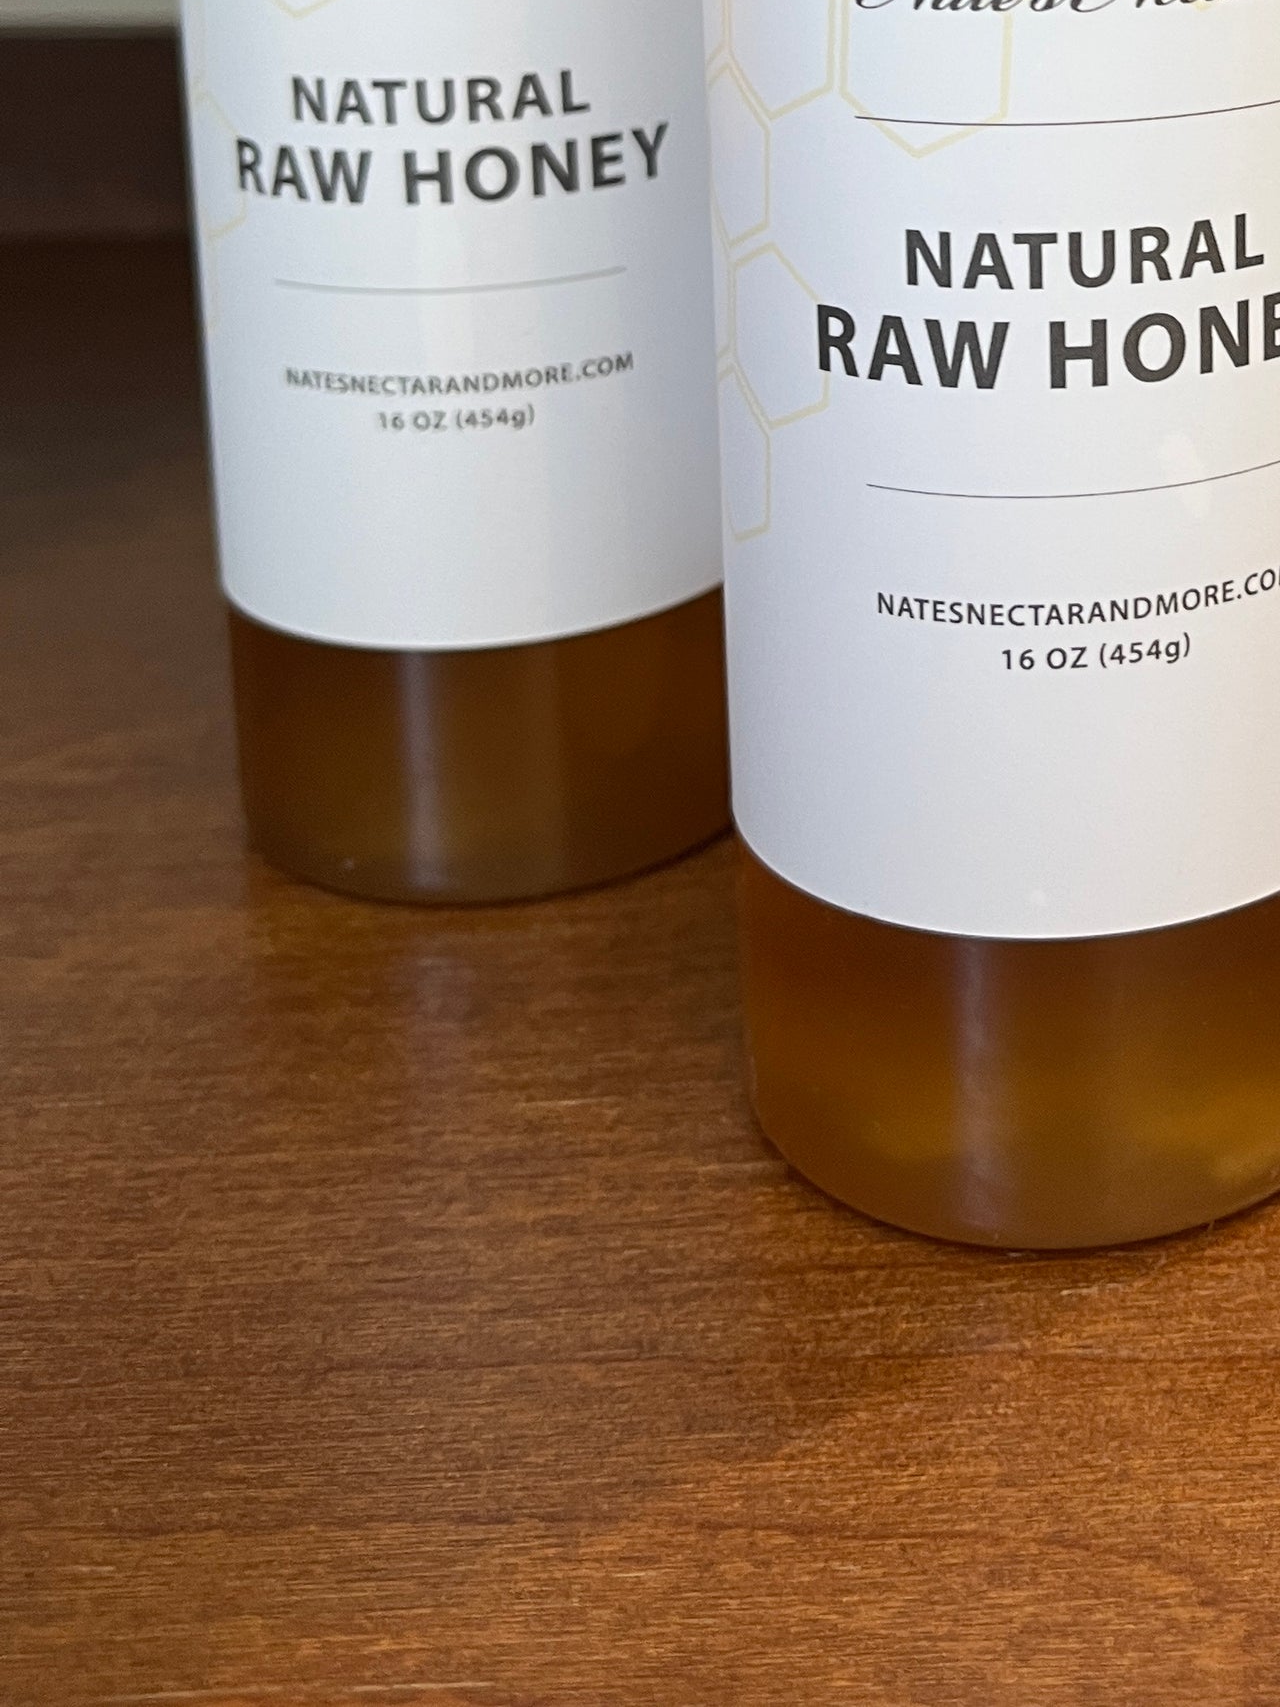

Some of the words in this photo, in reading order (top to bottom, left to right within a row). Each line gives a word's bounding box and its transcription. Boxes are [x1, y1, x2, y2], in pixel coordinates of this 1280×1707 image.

[292, 70, 590, 125] NATURAL
[236, 138, 372, 204] RAW
[403, 120, 667, 205] HONEY
[906, 213, 1264, 290] NATURAL
[817, 304, 1010, 389] RAW
[379, 412, 405, 430] 16
[414, 410, 447, 432] OZ
[454, 404, 534, 430] (454g)
[1002, 649, 1035, 670] 16
[1046, 647, 1088, 669] OZ
[1100, 632, 1190, 668] (454g)
